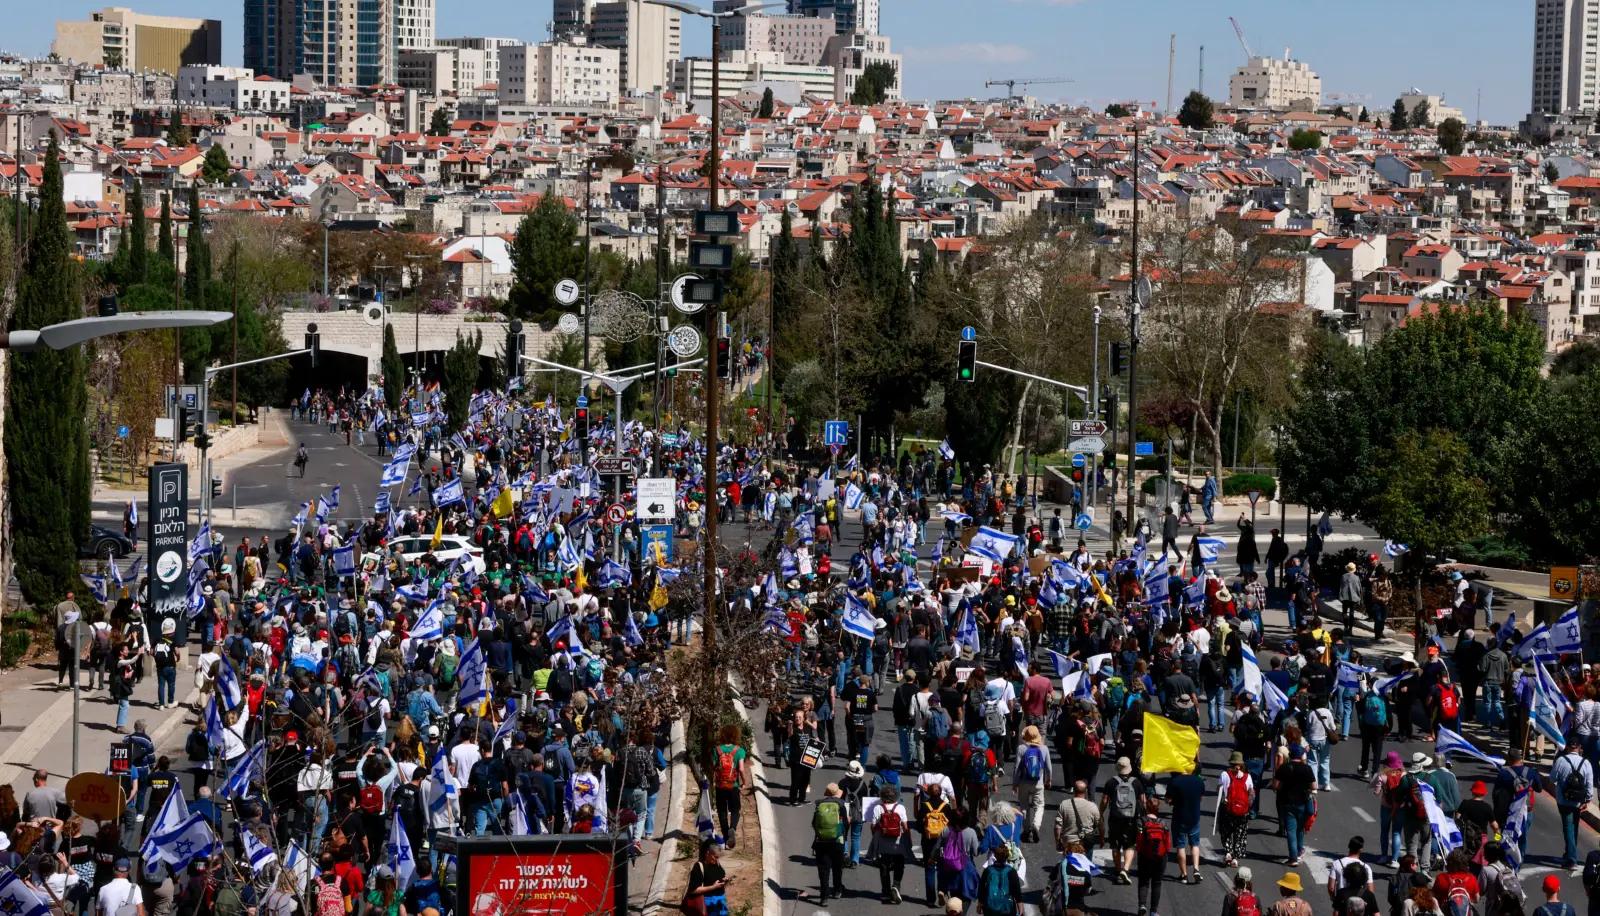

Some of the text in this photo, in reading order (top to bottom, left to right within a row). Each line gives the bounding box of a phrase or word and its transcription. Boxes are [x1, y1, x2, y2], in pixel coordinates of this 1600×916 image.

[160, 506, 180, 522] חניון
[154, 520, 184, 534] הלאום
[156, 536, 184, 546] PARKING
[516, 865, 572, 876] אי אפשר
[500, 879, 515, 890] זה
